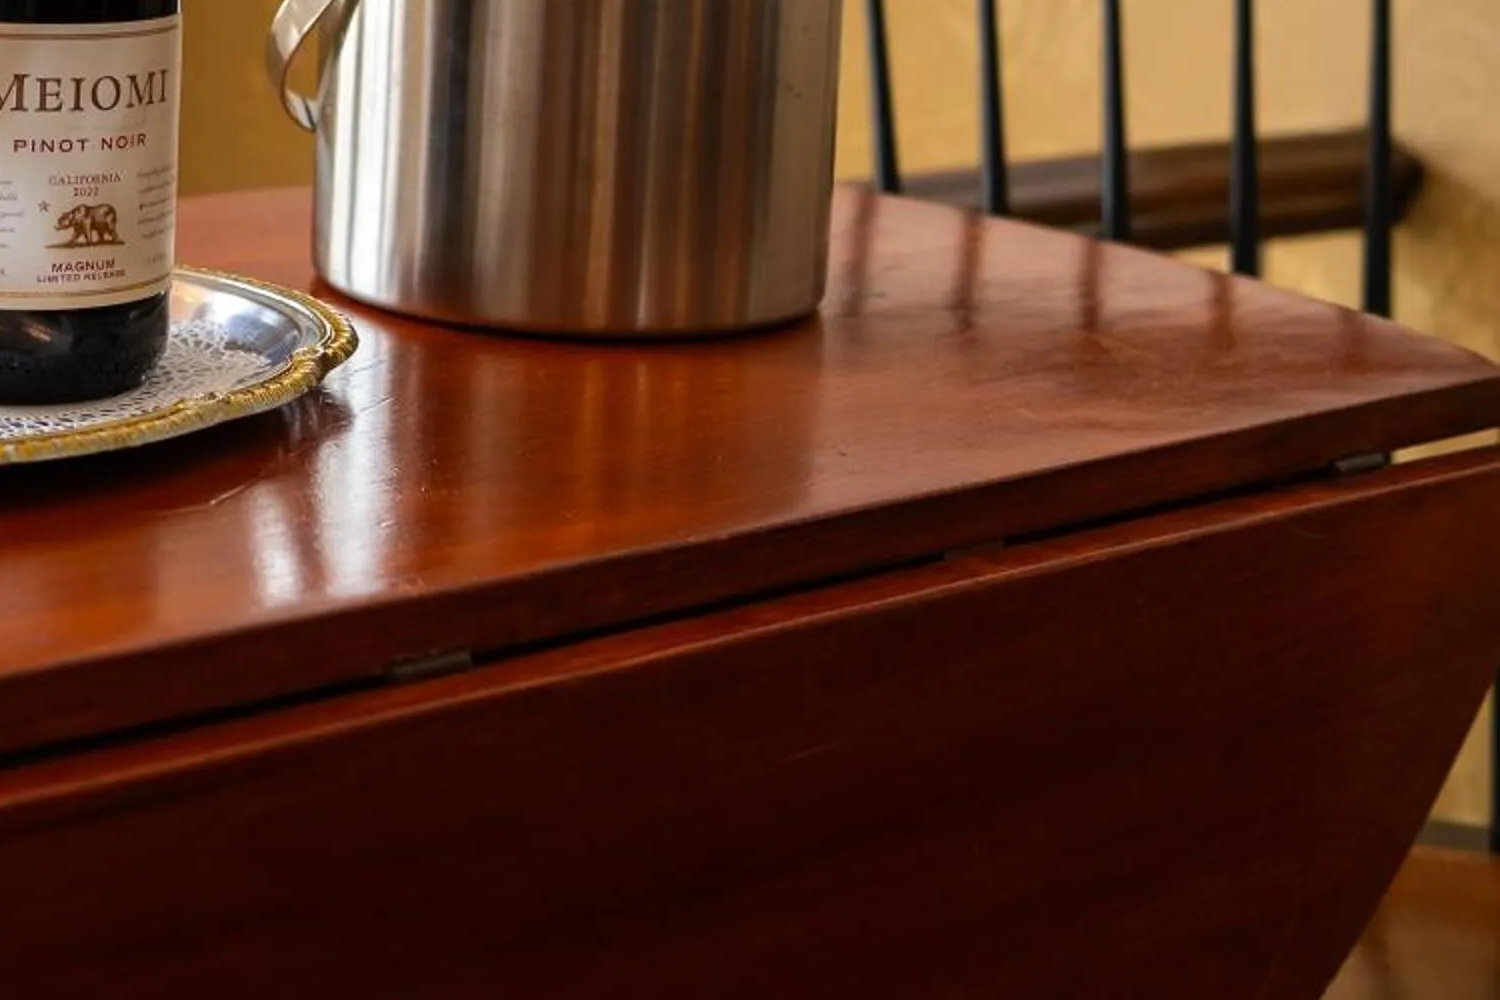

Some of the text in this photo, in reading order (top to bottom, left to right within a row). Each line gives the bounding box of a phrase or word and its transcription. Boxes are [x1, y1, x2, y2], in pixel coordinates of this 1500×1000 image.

[13, 133, 147, 153] PINOT NOIR
[48, 171, 124, 186] CALIFORNIA
[51, 258, 115, 273] MAGNUM
[37, 269, 126, 284] LIMITED RELEASE
